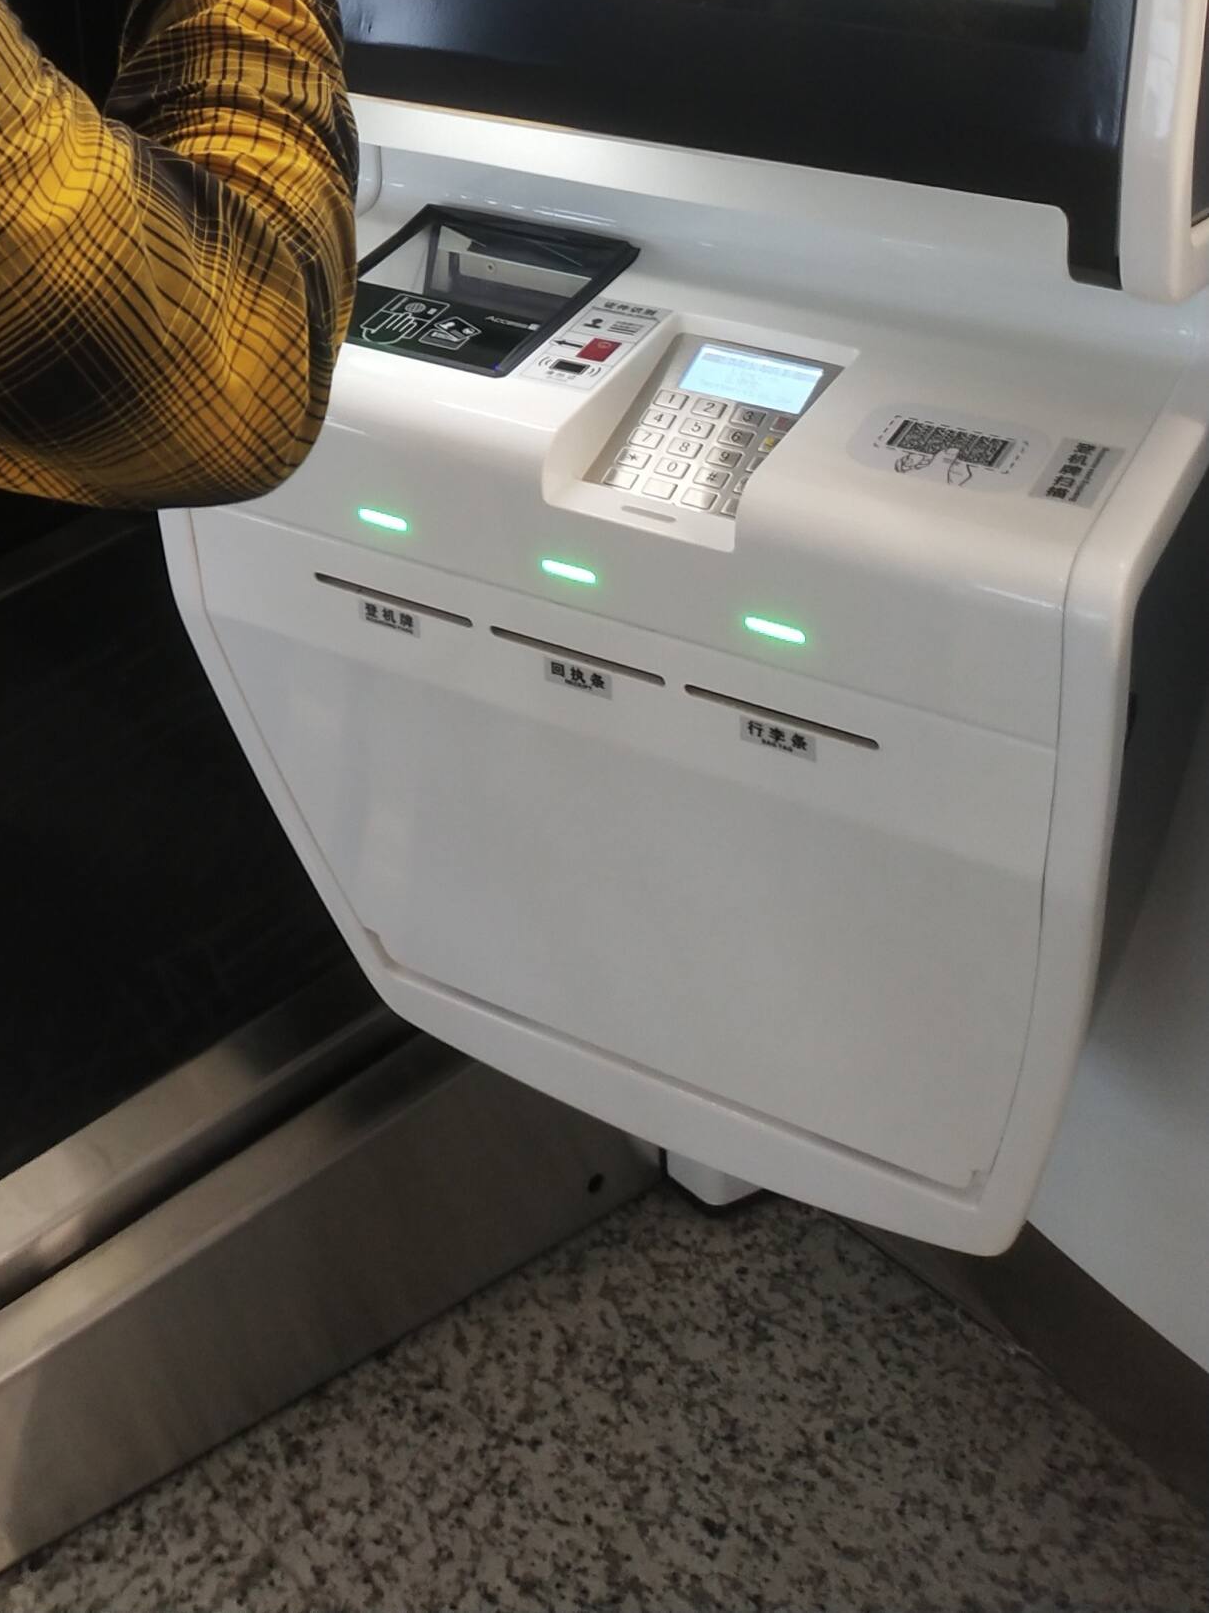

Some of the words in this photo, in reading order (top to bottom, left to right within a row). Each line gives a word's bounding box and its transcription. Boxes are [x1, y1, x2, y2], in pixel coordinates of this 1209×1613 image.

[364, 601, 415, 629] 登机牌
[550, 660, 606, 689] 回执条
[747, 719, 808, 751] 行李条
